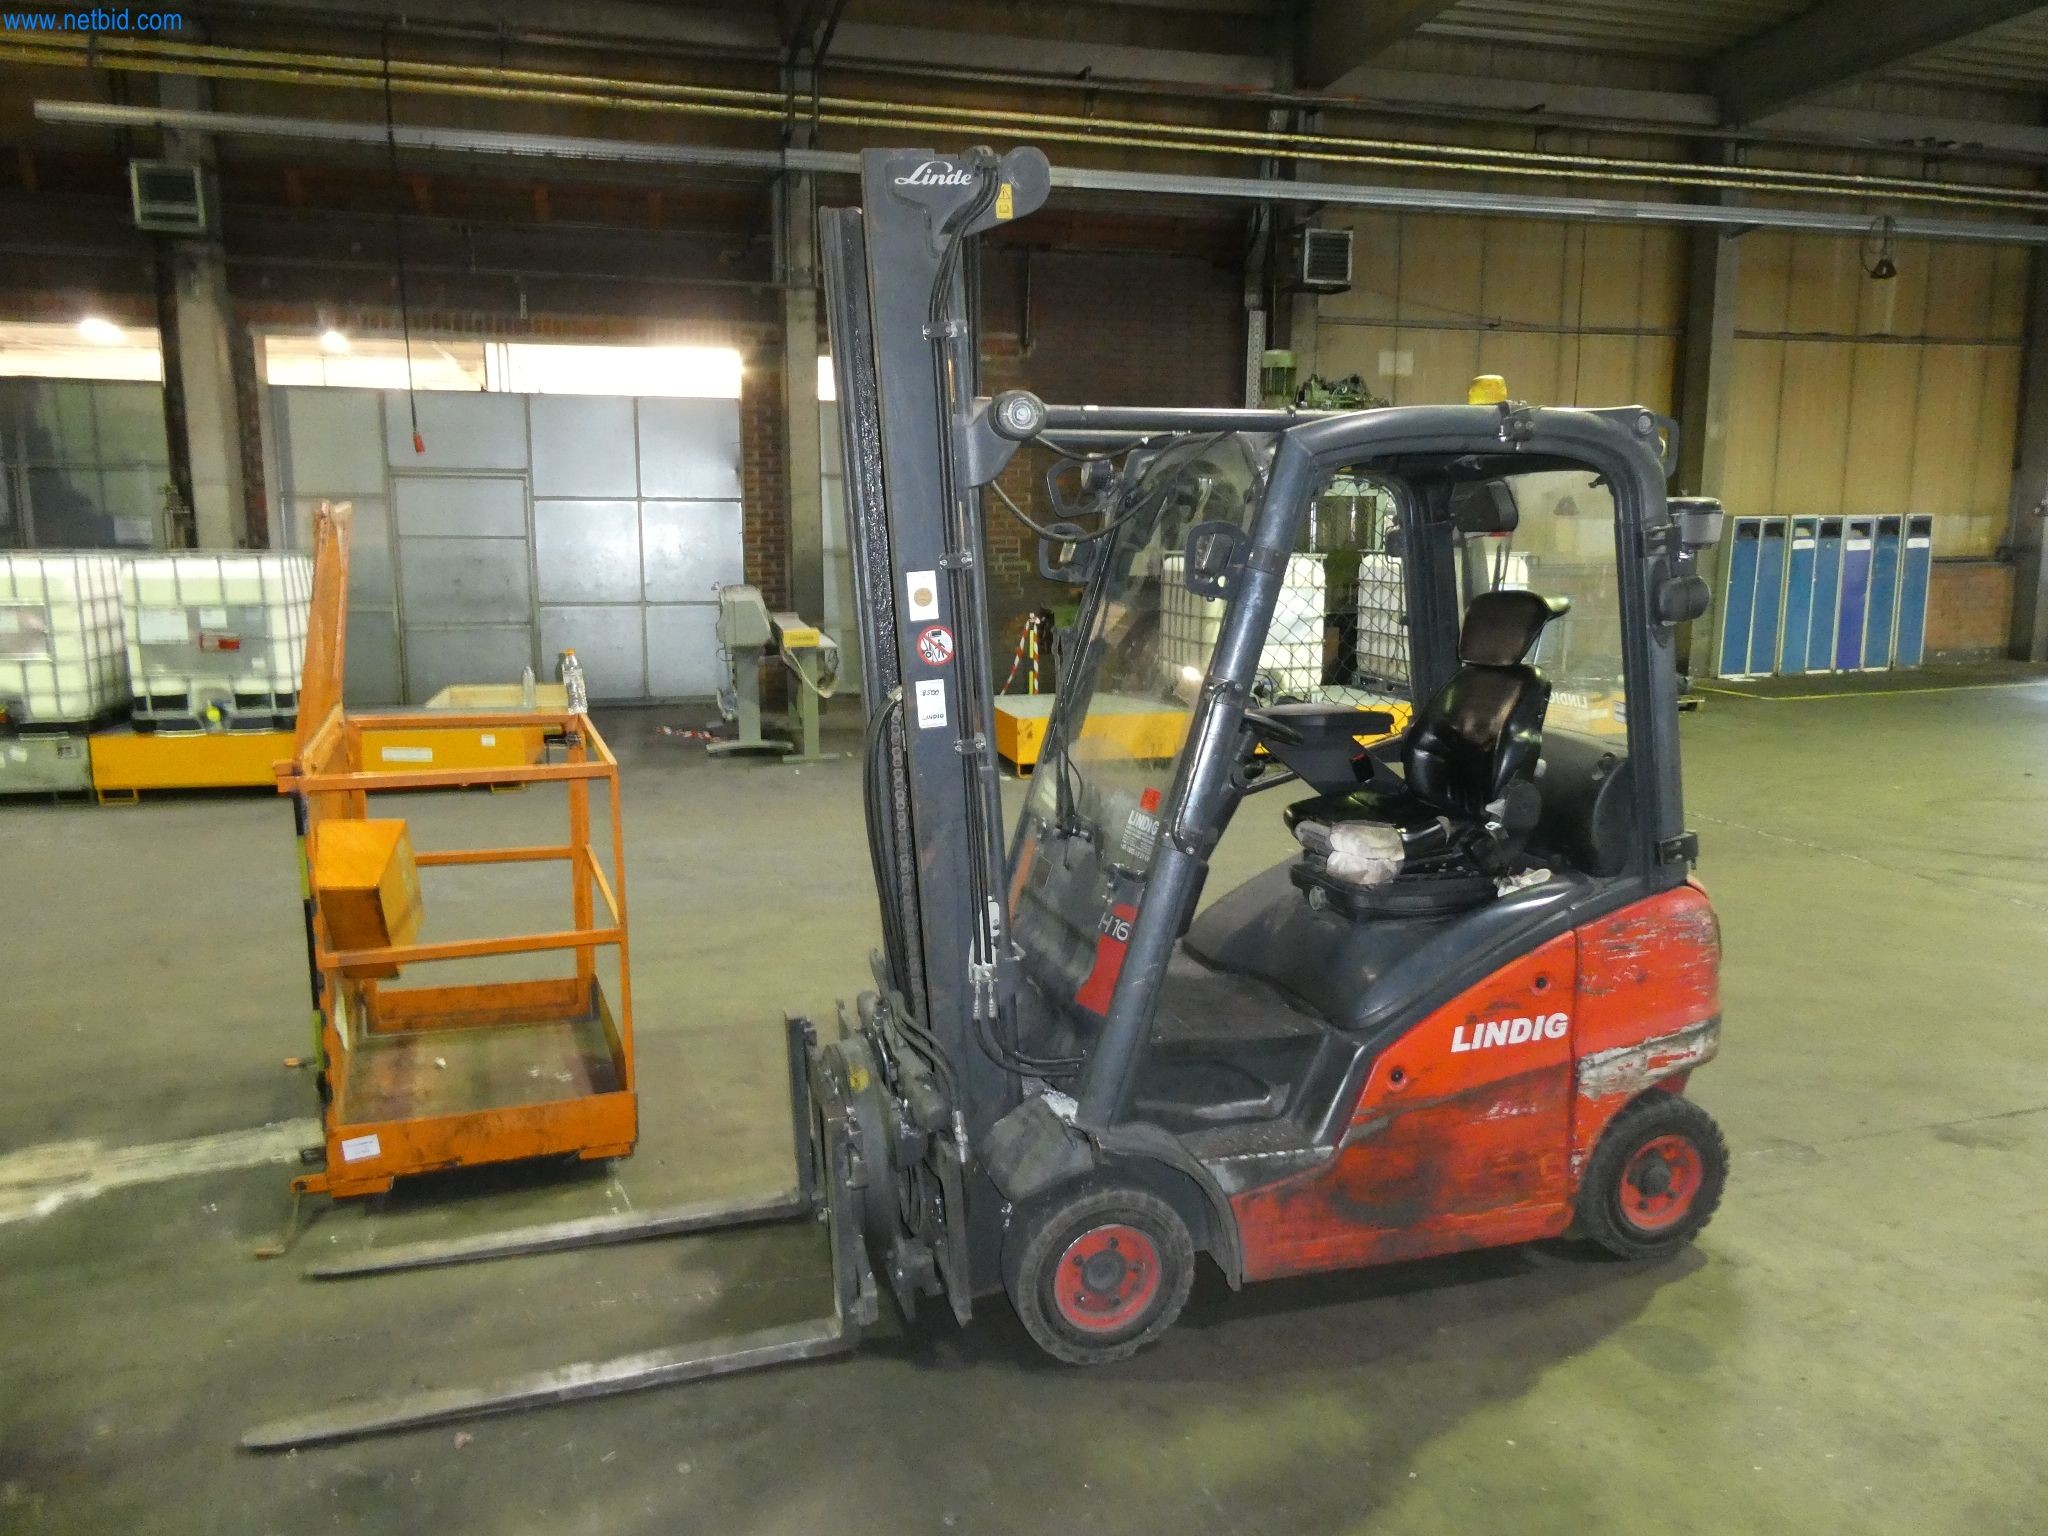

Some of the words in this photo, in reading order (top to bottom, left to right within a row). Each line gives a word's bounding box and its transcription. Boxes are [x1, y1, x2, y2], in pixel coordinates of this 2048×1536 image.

[894, 160, 972, 185] Linde
[1127, 809, 1160, 836] LINDIG
[1450, 1012, 1569, 1053] LINDIG
